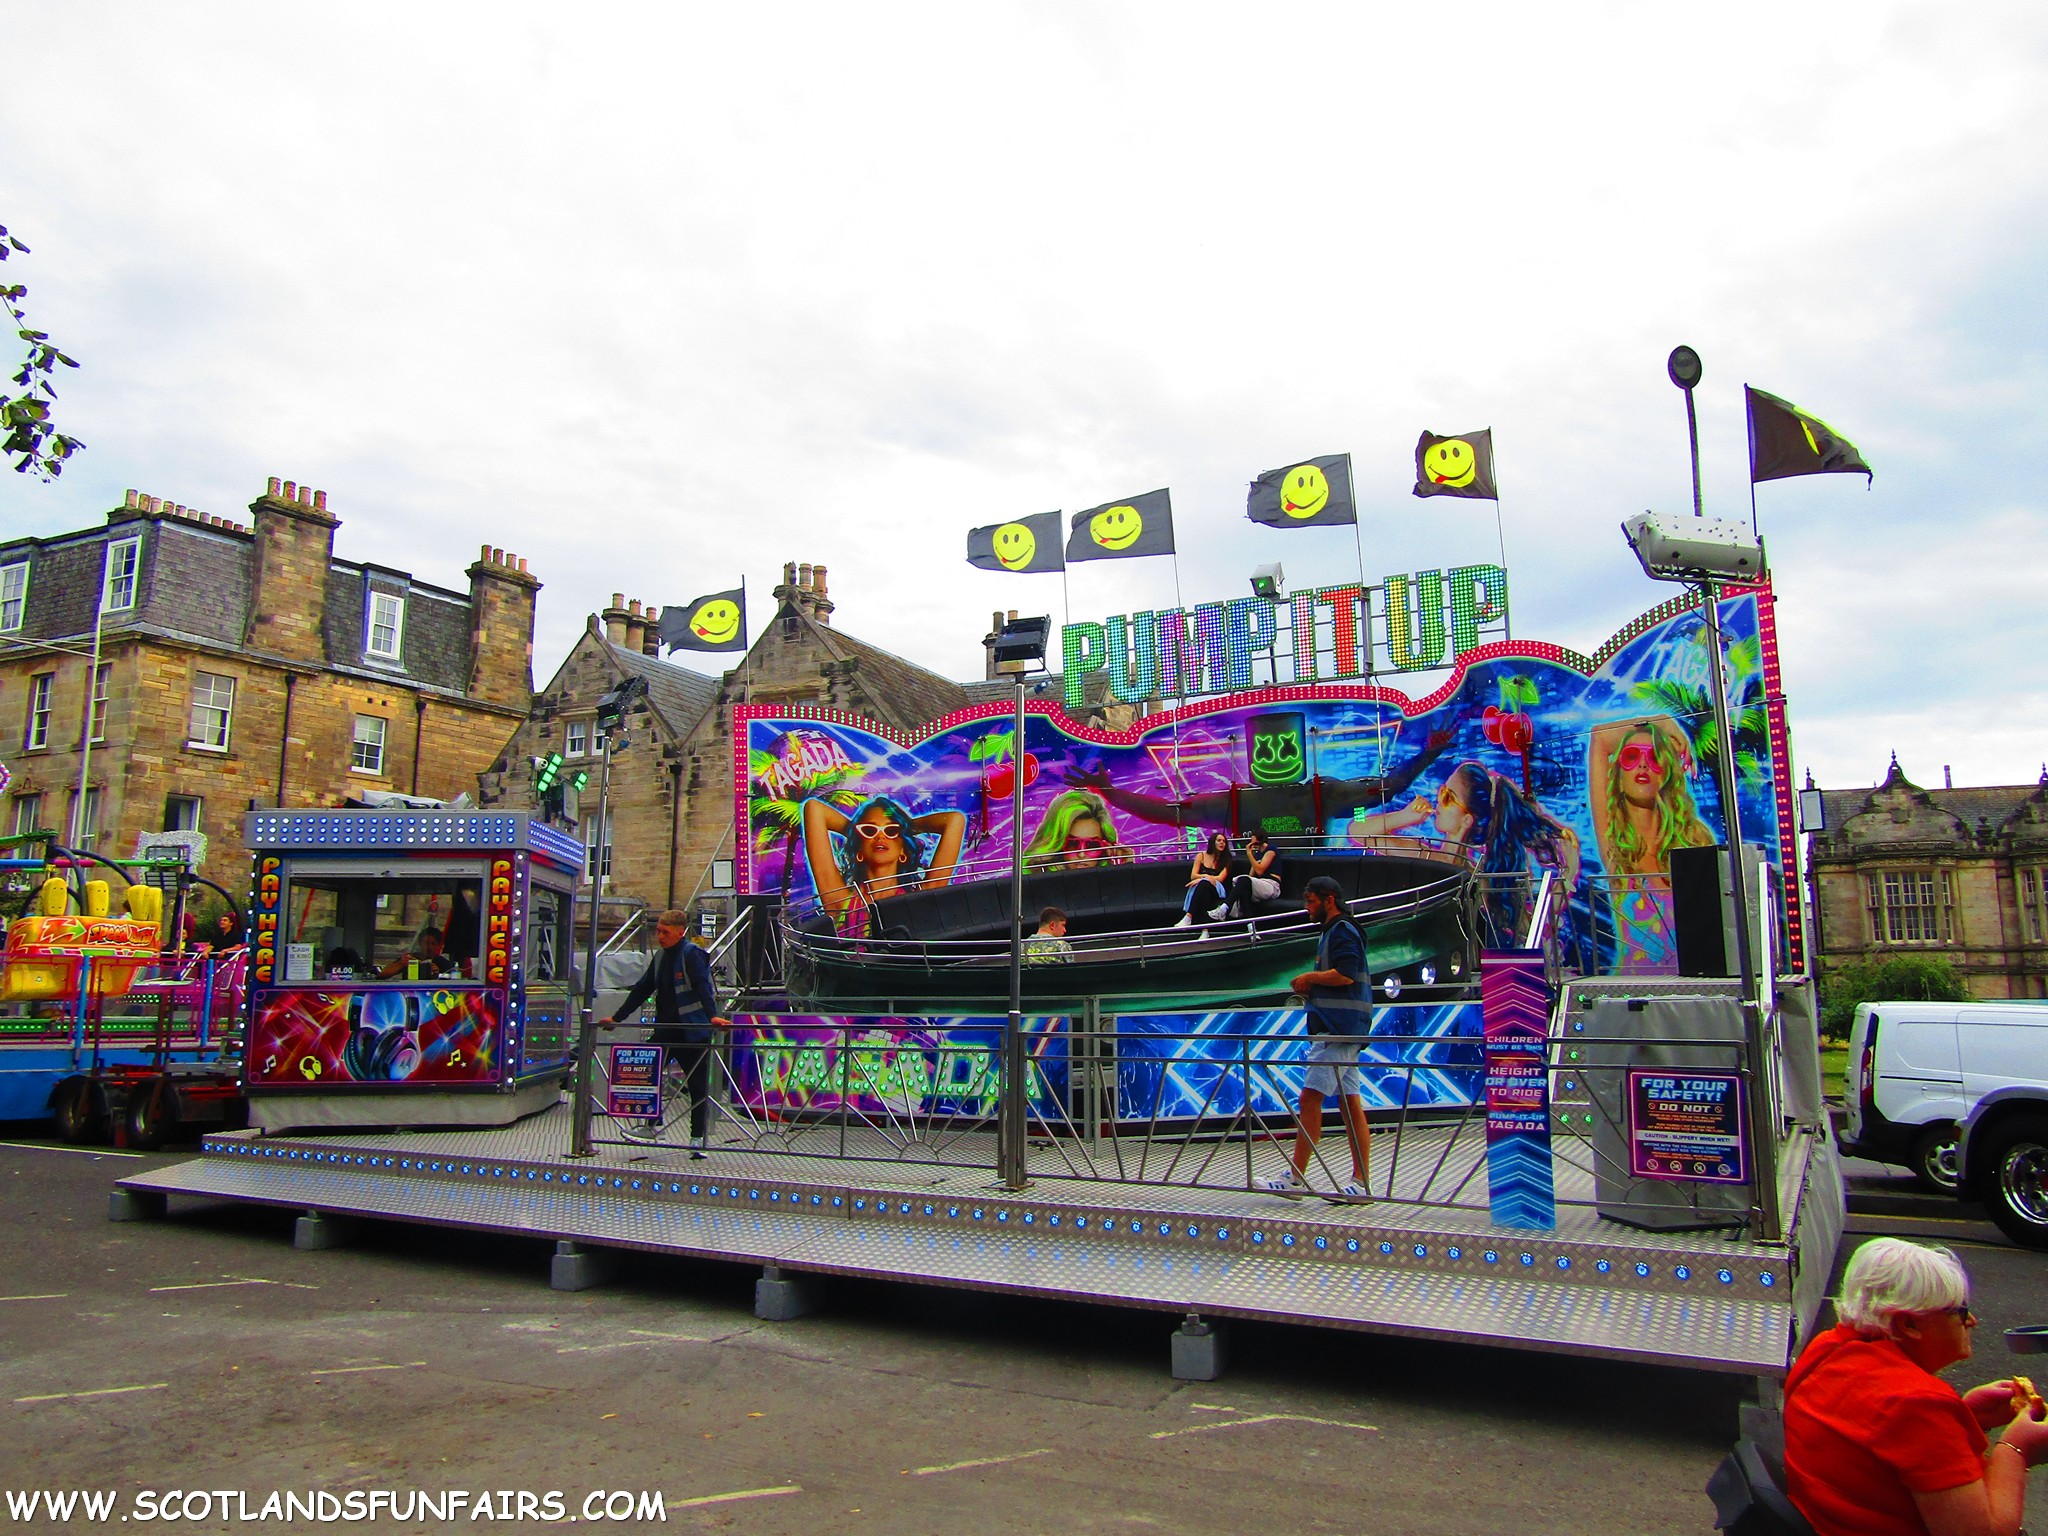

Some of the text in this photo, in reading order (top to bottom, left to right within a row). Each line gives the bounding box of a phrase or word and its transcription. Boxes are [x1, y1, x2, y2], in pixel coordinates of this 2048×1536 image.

[1062, 564, 1507, 710] PUMP IT UP
[759, 741, 857, 803] TAGADA
[256, 857, 280, 983] PAY HERE
[488, 860, 511, 983] PAY HERE
[1490, 1067, 1541, 1076] HEIGHT
[1485, 1077, 1548, 1087] OR OVER
[1641, 1078, 1728, 1091] FOR YOUR
[1490, 1088, 1542, 1097] TO RIDE
[1647, 1088, 1721, 1101] SAFETY!
[1659, 1103, 1711, 1113] DO NOT
[1489, 1112, 1545, 1120] PUMP-IT-UP
[1488, 1120, 1546, 1131] TAGADA
